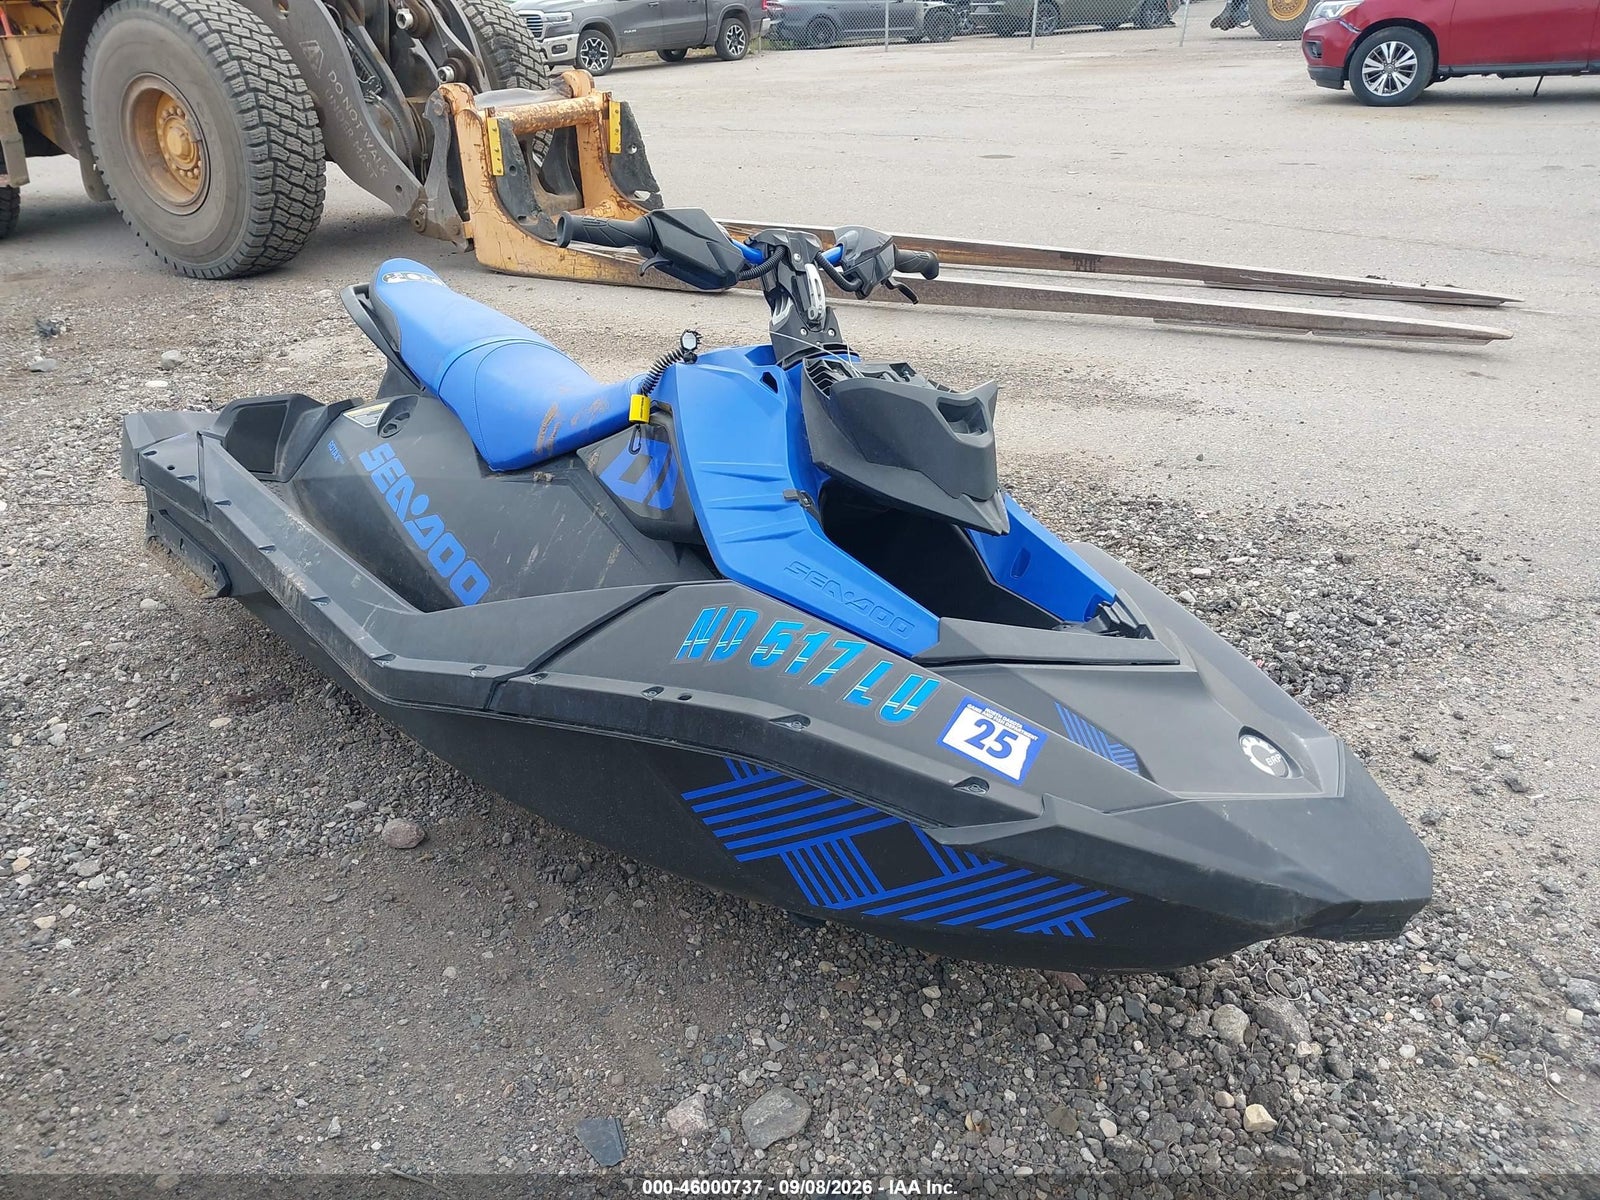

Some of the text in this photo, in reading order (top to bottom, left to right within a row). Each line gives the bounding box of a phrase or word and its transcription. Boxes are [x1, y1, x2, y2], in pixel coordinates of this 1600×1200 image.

[328, 70, 389, 177] DO NOT WALK
[675, 606, 941, 723] ND 517 LU
[964, 718, 1019, 759] 25
[1265, 753, 1281, 766] BRP
